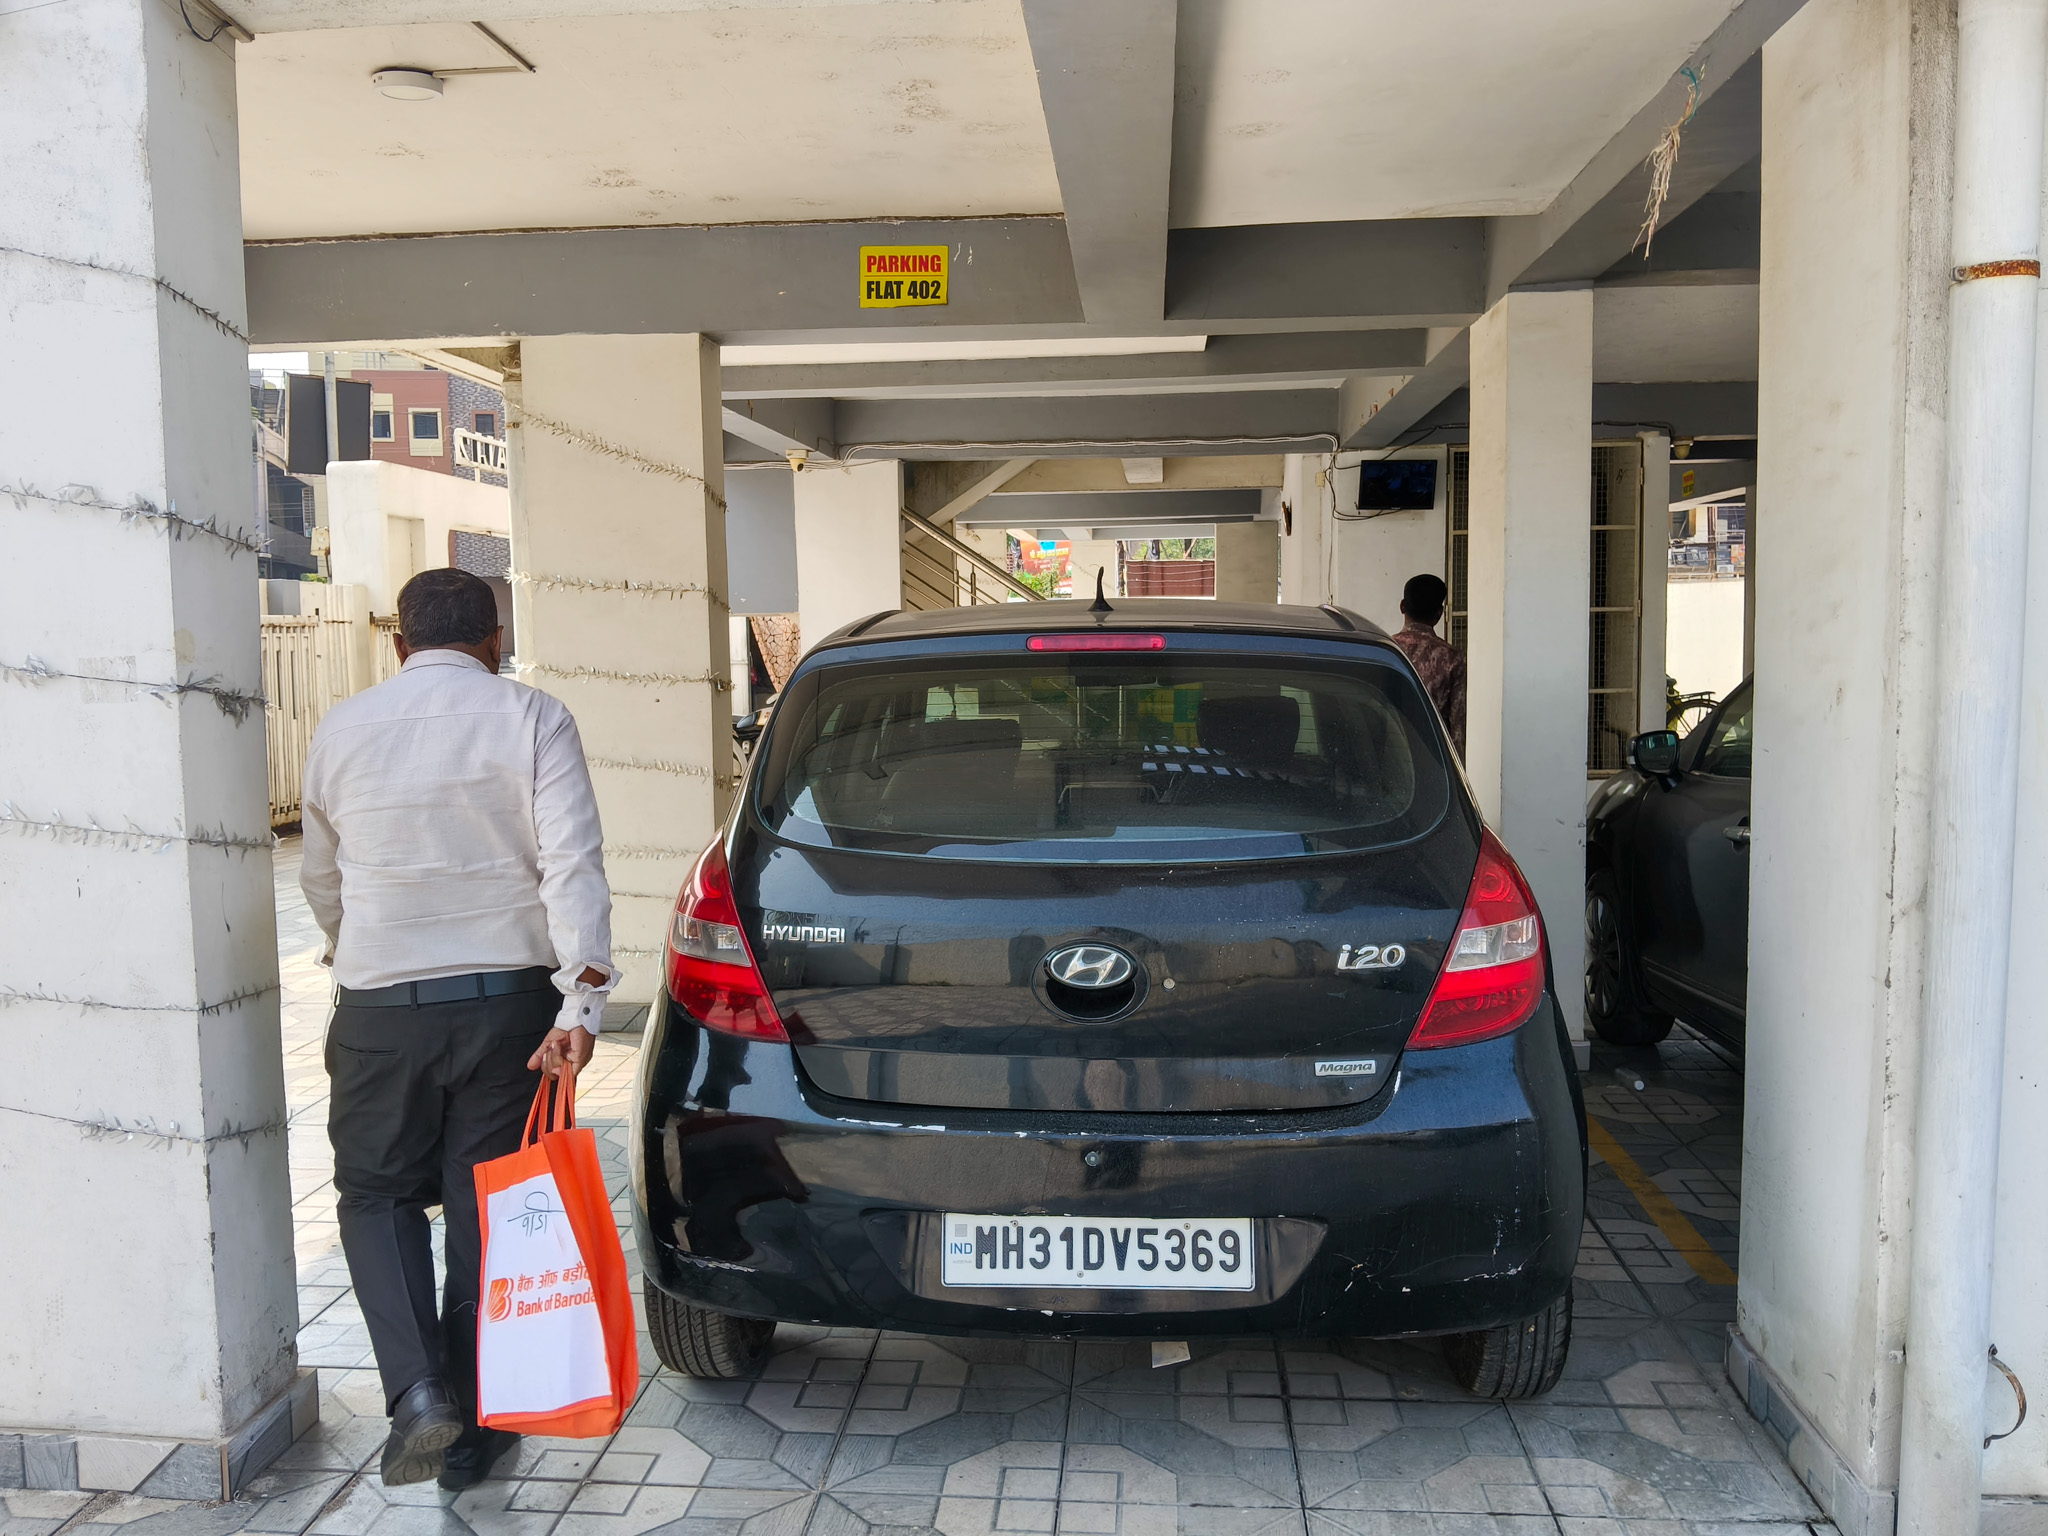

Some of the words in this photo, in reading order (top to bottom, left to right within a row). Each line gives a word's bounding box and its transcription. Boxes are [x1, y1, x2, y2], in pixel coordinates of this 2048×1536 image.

[866, 254, 942, 273] PARKING
[866, 280, 904, 299] FLAT
[907, 280, 941, 299] 402
[763, 924, 846, 943] HYUNDAI
[1337, 944, 1406, 970] i20
[1319, 1061, 1373, 1074] Magna
[950, 1242, 973, 1255] IND
[975, 1225, 1241, 1273] MH31DV5369
[517, 1273, 535, 1293] बैंक
[517, 1297, 543, 1317] Bank
[544, 1294, 554, 1312] of
